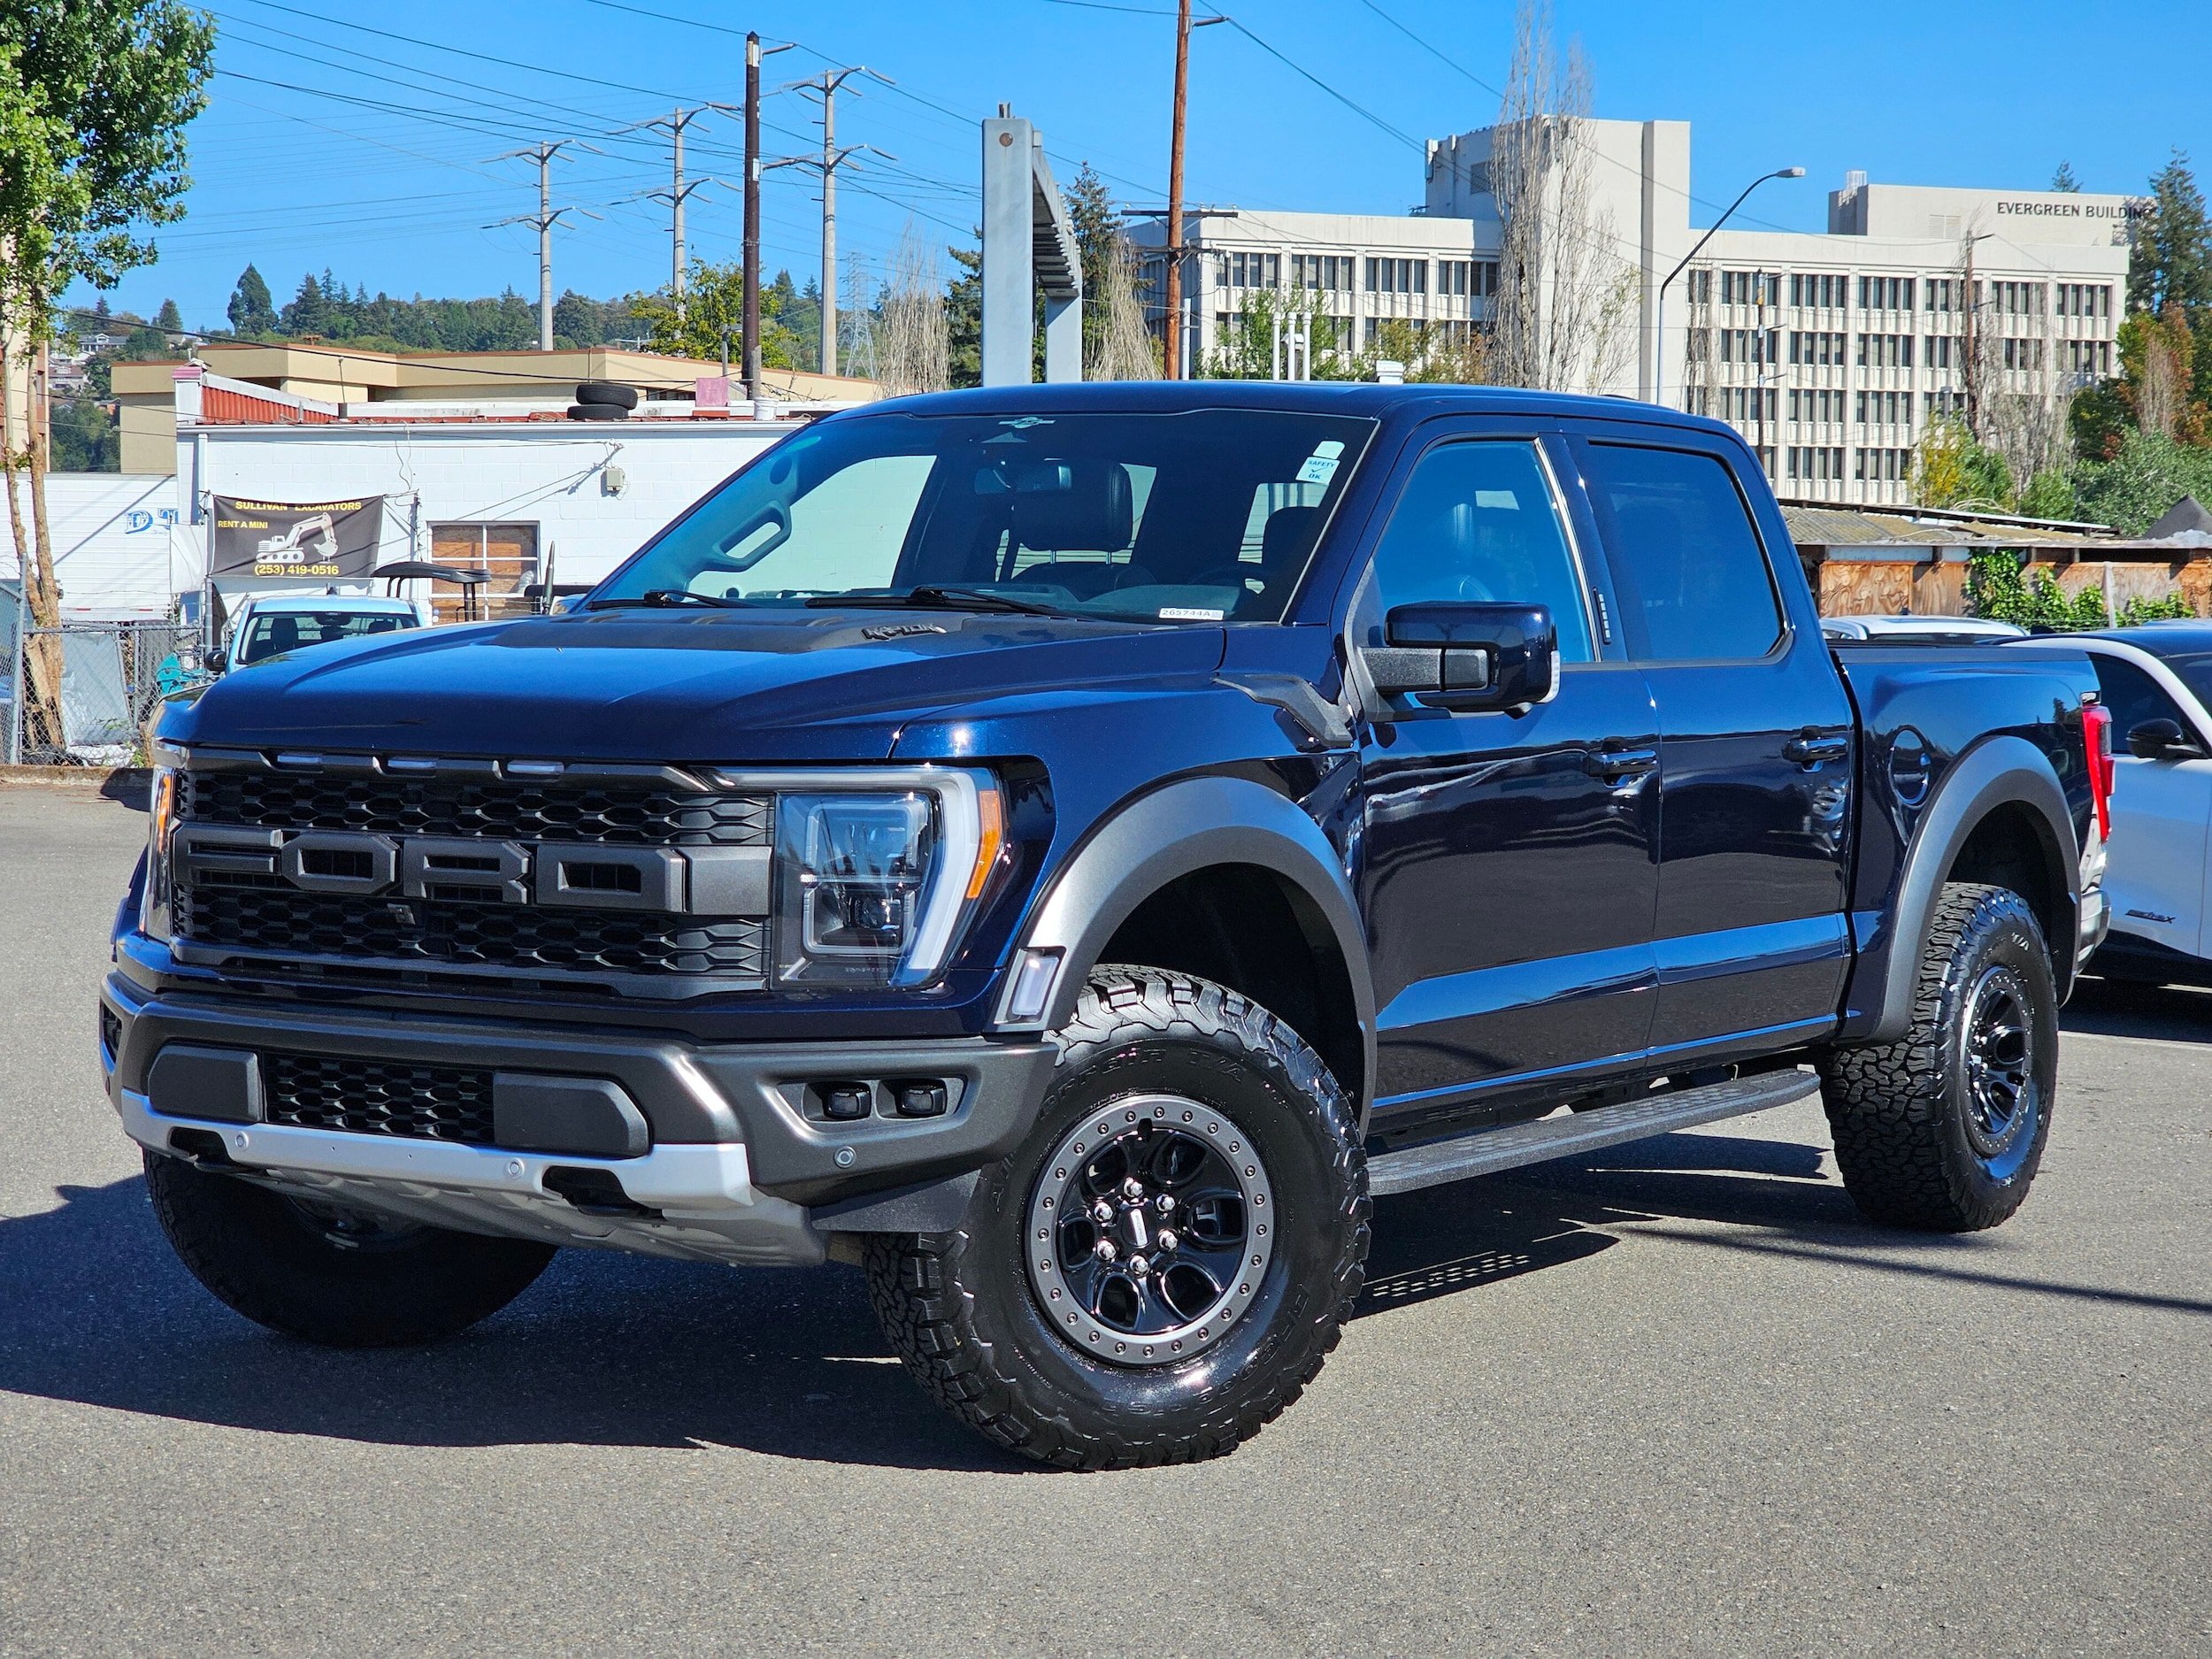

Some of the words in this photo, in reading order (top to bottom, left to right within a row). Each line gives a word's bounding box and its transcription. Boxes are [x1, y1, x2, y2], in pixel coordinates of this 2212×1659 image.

[1997, 202, 2080, 218] EVERGREEN
[254, 564, 285, 576] (253)
[287, 565, 340, 575] 419-0516
[170, 820, 687, 915] FORD
